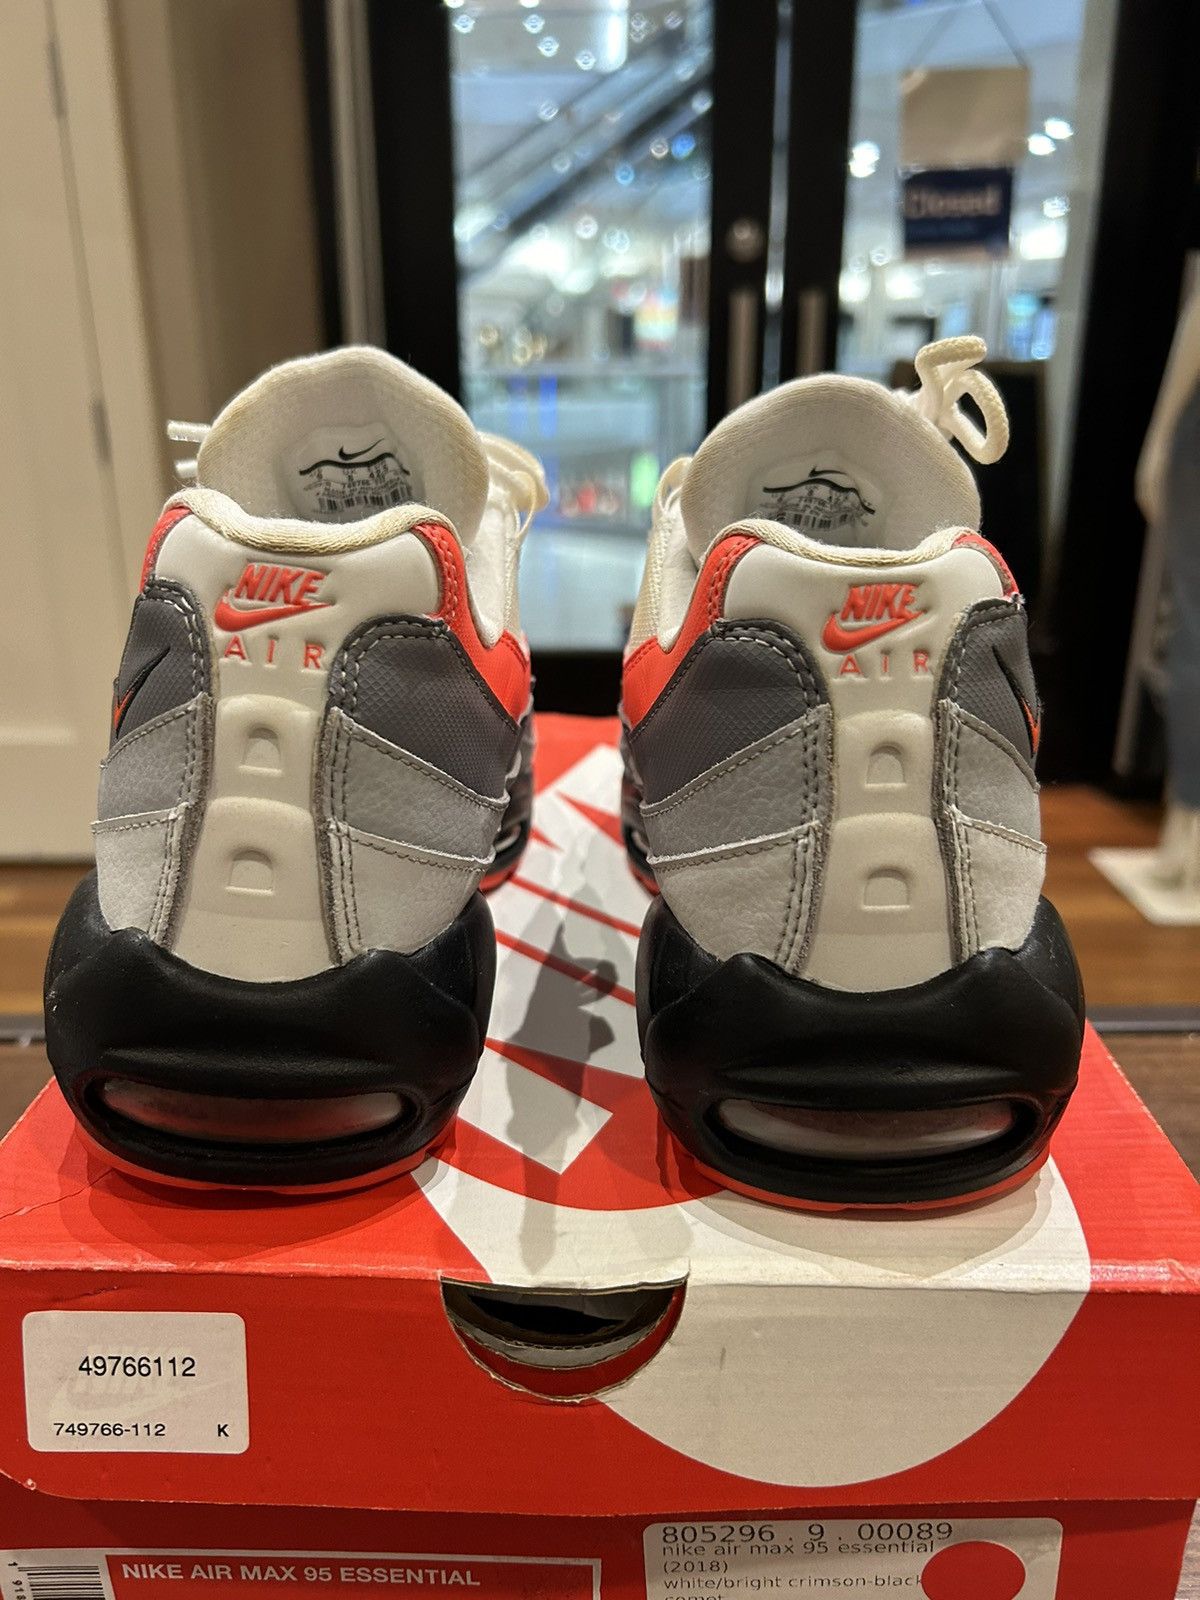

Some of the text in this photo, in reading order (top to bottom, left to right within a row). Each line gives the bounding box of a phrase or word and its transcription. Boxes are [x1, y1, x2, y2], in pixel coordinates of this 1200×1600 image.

[233, 562, 326, 605] NIKE
[840, 583, 919, 620] NIKE
[224, 636, 325, 670] AIR
[839, 649, 930, 676] AIR
[78, 1356, 196, 1378] 49766112
[53, 1422, 229, 1437] 749766-112 K
[662, 1525, 775, 1543] 805296
[808, 1523, 825, 1541] 9
[858, 1522, 953, 1541] 00089
[663, 1540, 934, 1556] nike air max 95 essential
[121, 1563, 481, 1586] NIKE AIR MAX 95 ESSENTIAL
[663, 1561, 728, 1574] (2018)
[664, 1576, 781, 1590] white/bright
